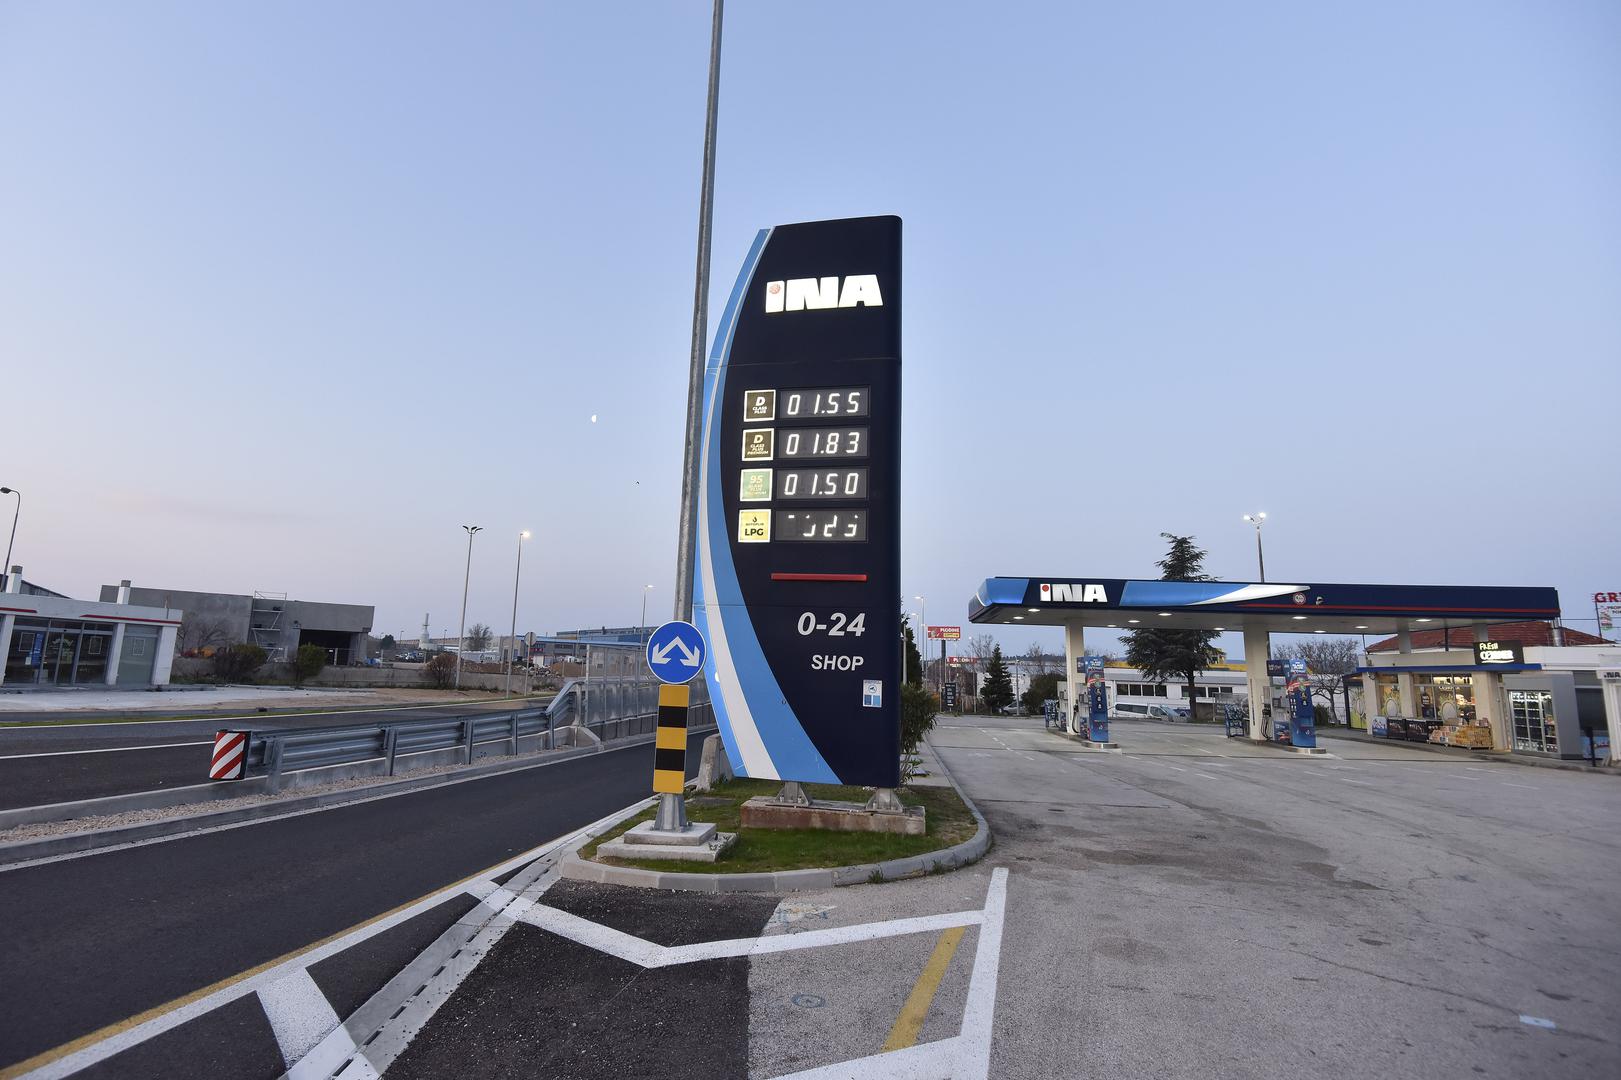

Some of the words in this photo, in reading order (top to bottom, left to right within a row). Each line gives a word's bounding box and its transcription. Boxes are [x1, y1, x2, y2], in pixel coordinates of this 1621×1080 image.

[755, 396, 766, 406] D
[753, 434, 763, 444] D
[744, 528, 764, 536] LPG
[797, 612, 865, 637] 0-24
[811, 654, 864, 671] SHOP
